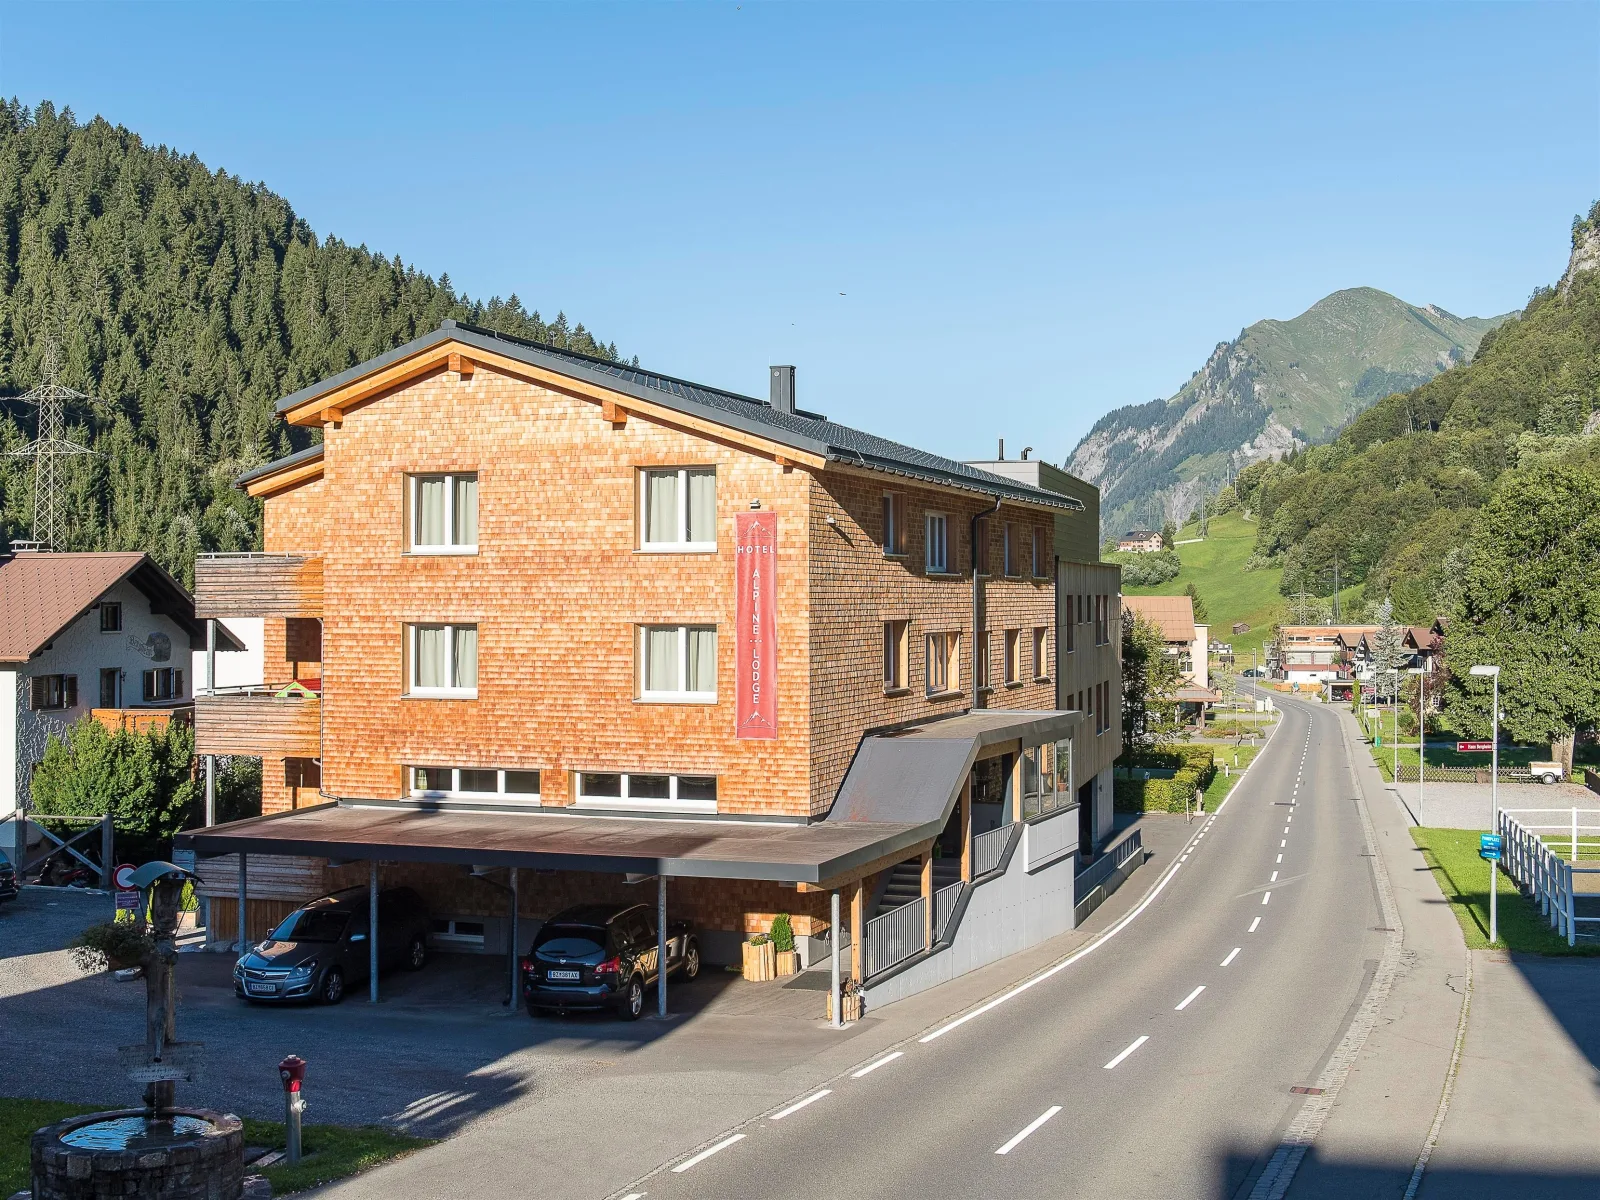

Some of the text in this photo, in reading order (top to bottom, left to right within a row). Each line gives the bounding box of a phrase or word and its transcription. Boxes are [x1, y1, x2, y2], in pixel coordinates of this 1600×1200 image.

[737, 545, 775, 554] HOTEL
[752, 568, 760, 635] ALPINE
[752, 649, 760, 704] LODGE
